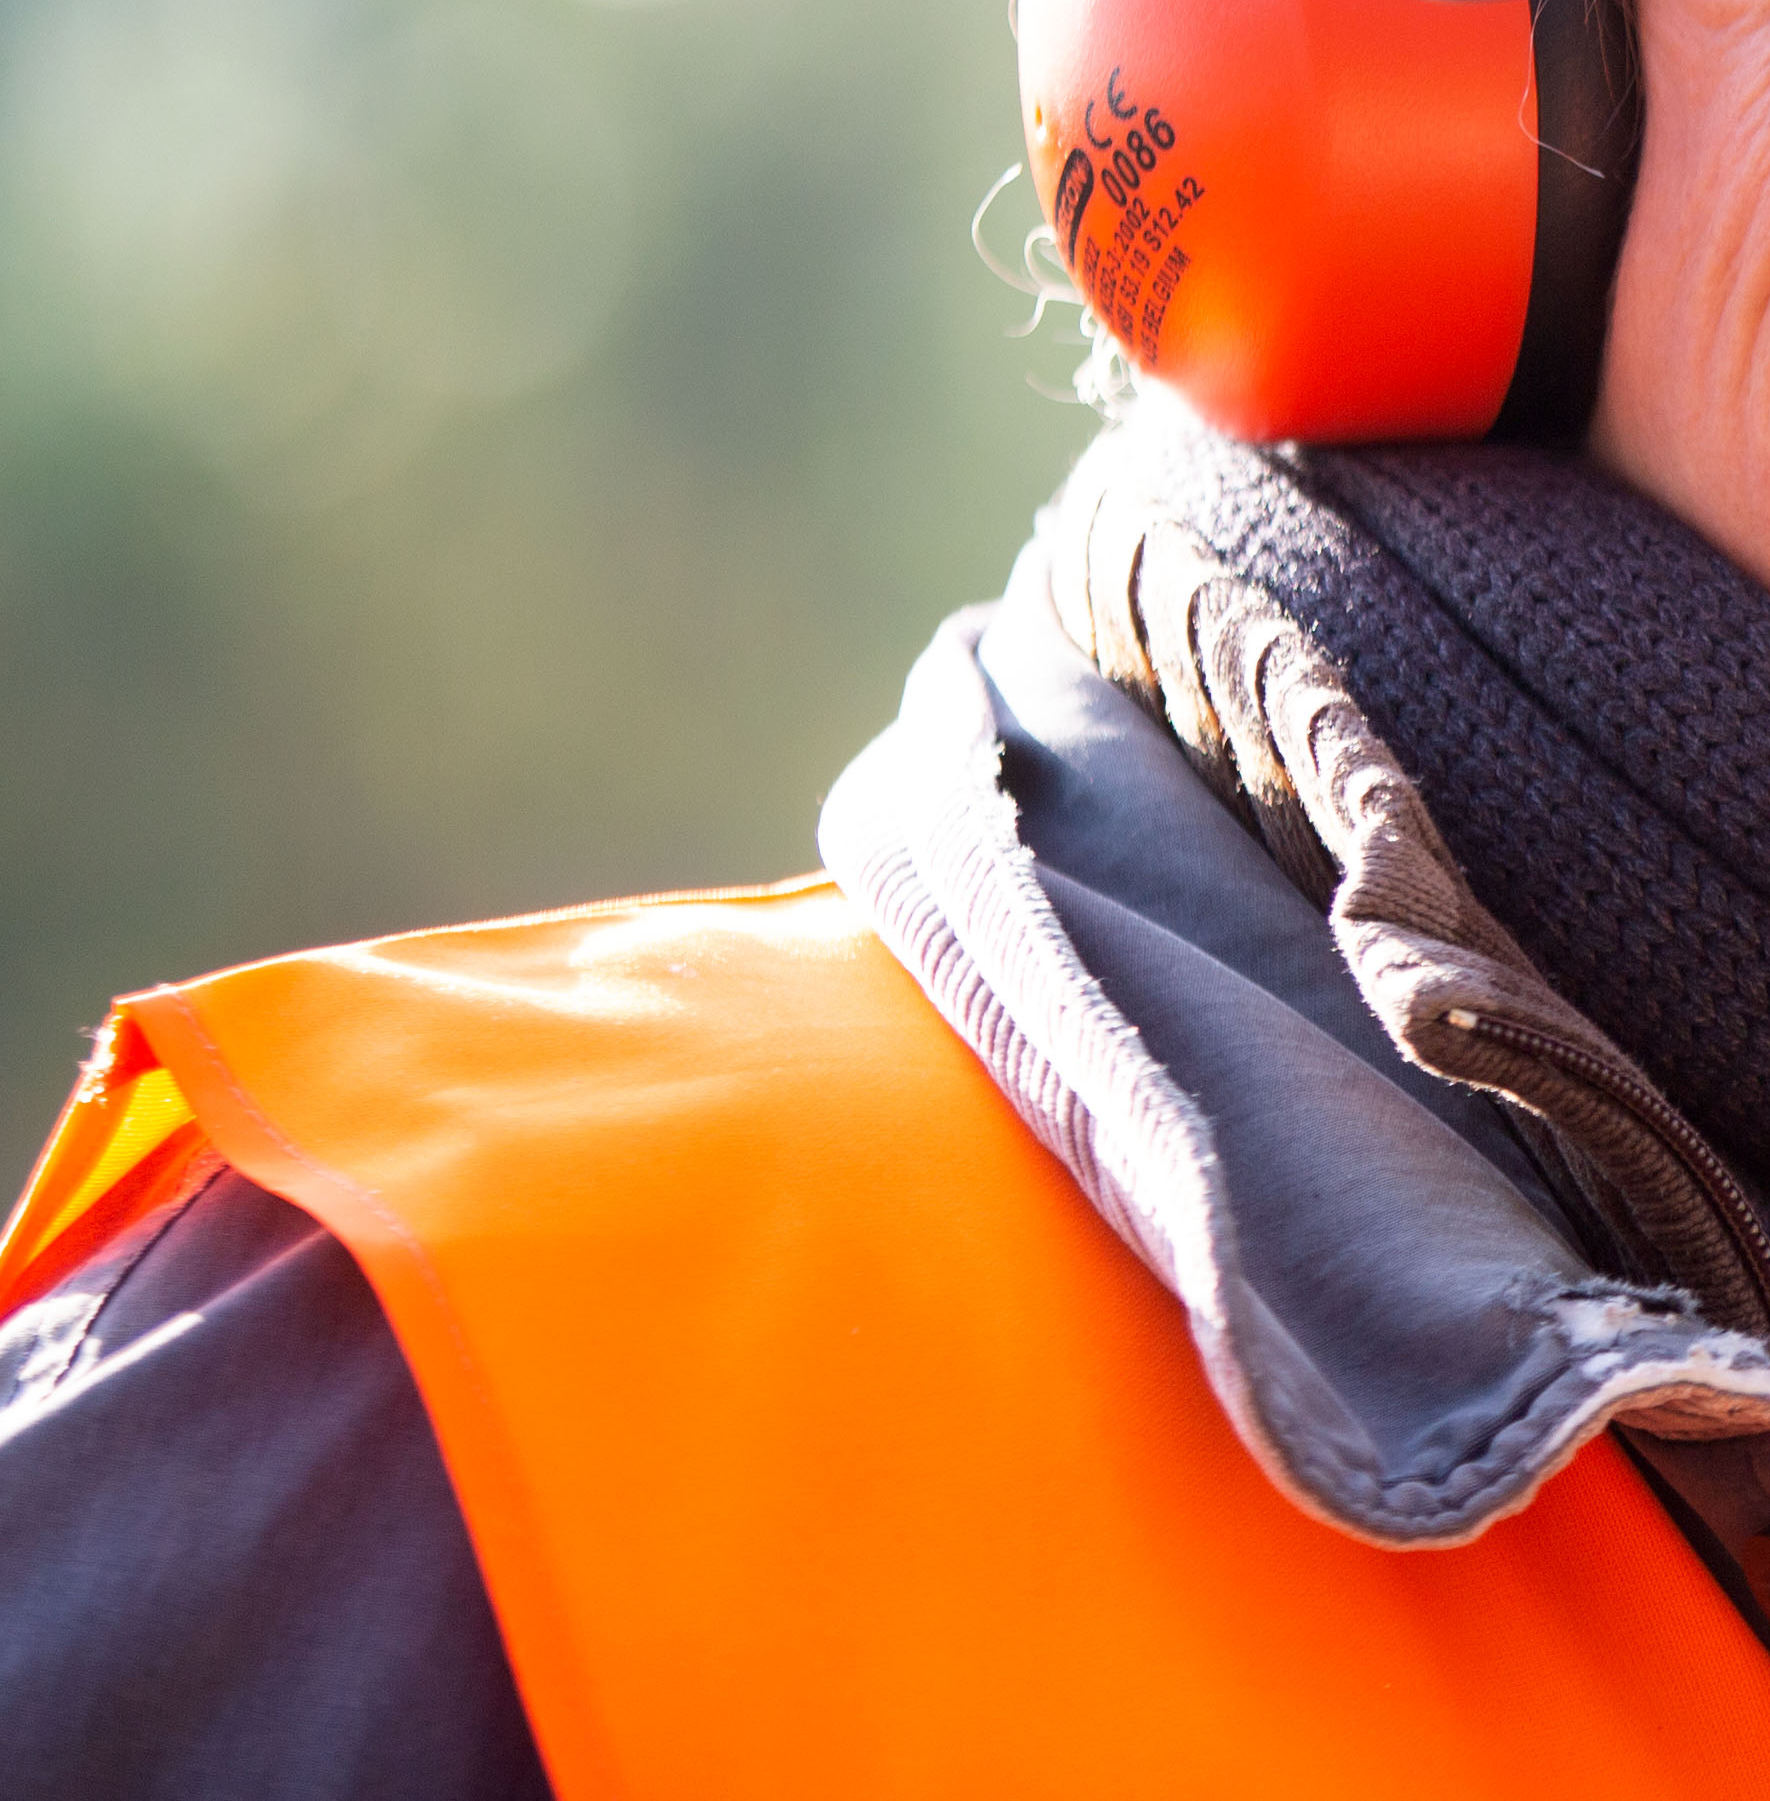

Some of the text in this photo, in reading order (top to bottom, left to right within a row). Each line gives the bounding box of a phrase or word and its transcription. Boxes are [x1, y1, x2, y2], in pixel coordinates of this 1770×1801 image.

[1101, 108, 1176, 207] 0086
[1120, 249, 1150, 306] S3.19
[1144, 177, 1205, 251] S12.42
[1143, 246, 1191, 335] BELGIUM
